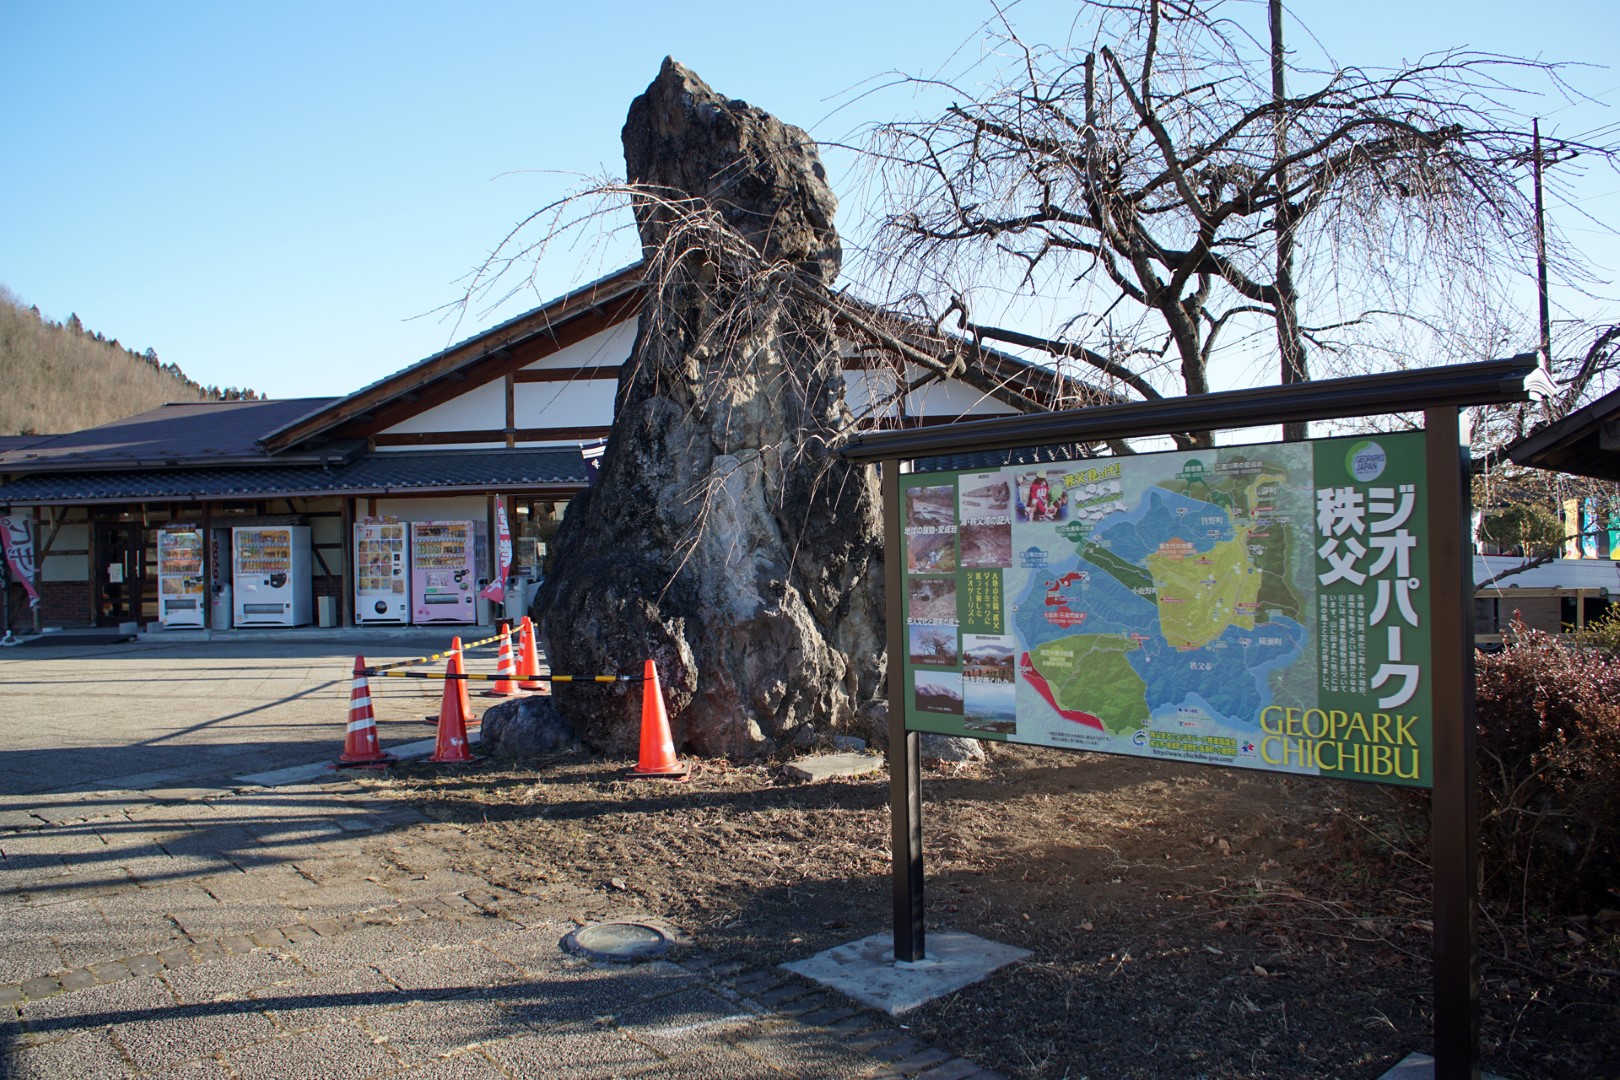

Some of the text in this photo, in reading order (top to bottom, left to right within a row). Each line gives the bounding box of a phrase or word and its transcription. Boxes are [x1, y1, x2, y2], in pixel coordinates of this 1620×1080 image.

[1355, 453, 1385, 463] GEOPARKS
[1356, 462, 1378, 471] JAPAN
[1316, 486, 1368, 586] 秩父
[967, 572, 975, 625] ジオツーリズム
[1368, 484, 1421, 709] ジオパーク
[1190, 661, 1213, 671] 秩父市
[1259, 705, 1419, 747] GEOPARK
[1260, 735, 1420, 780] CHICHIBU
